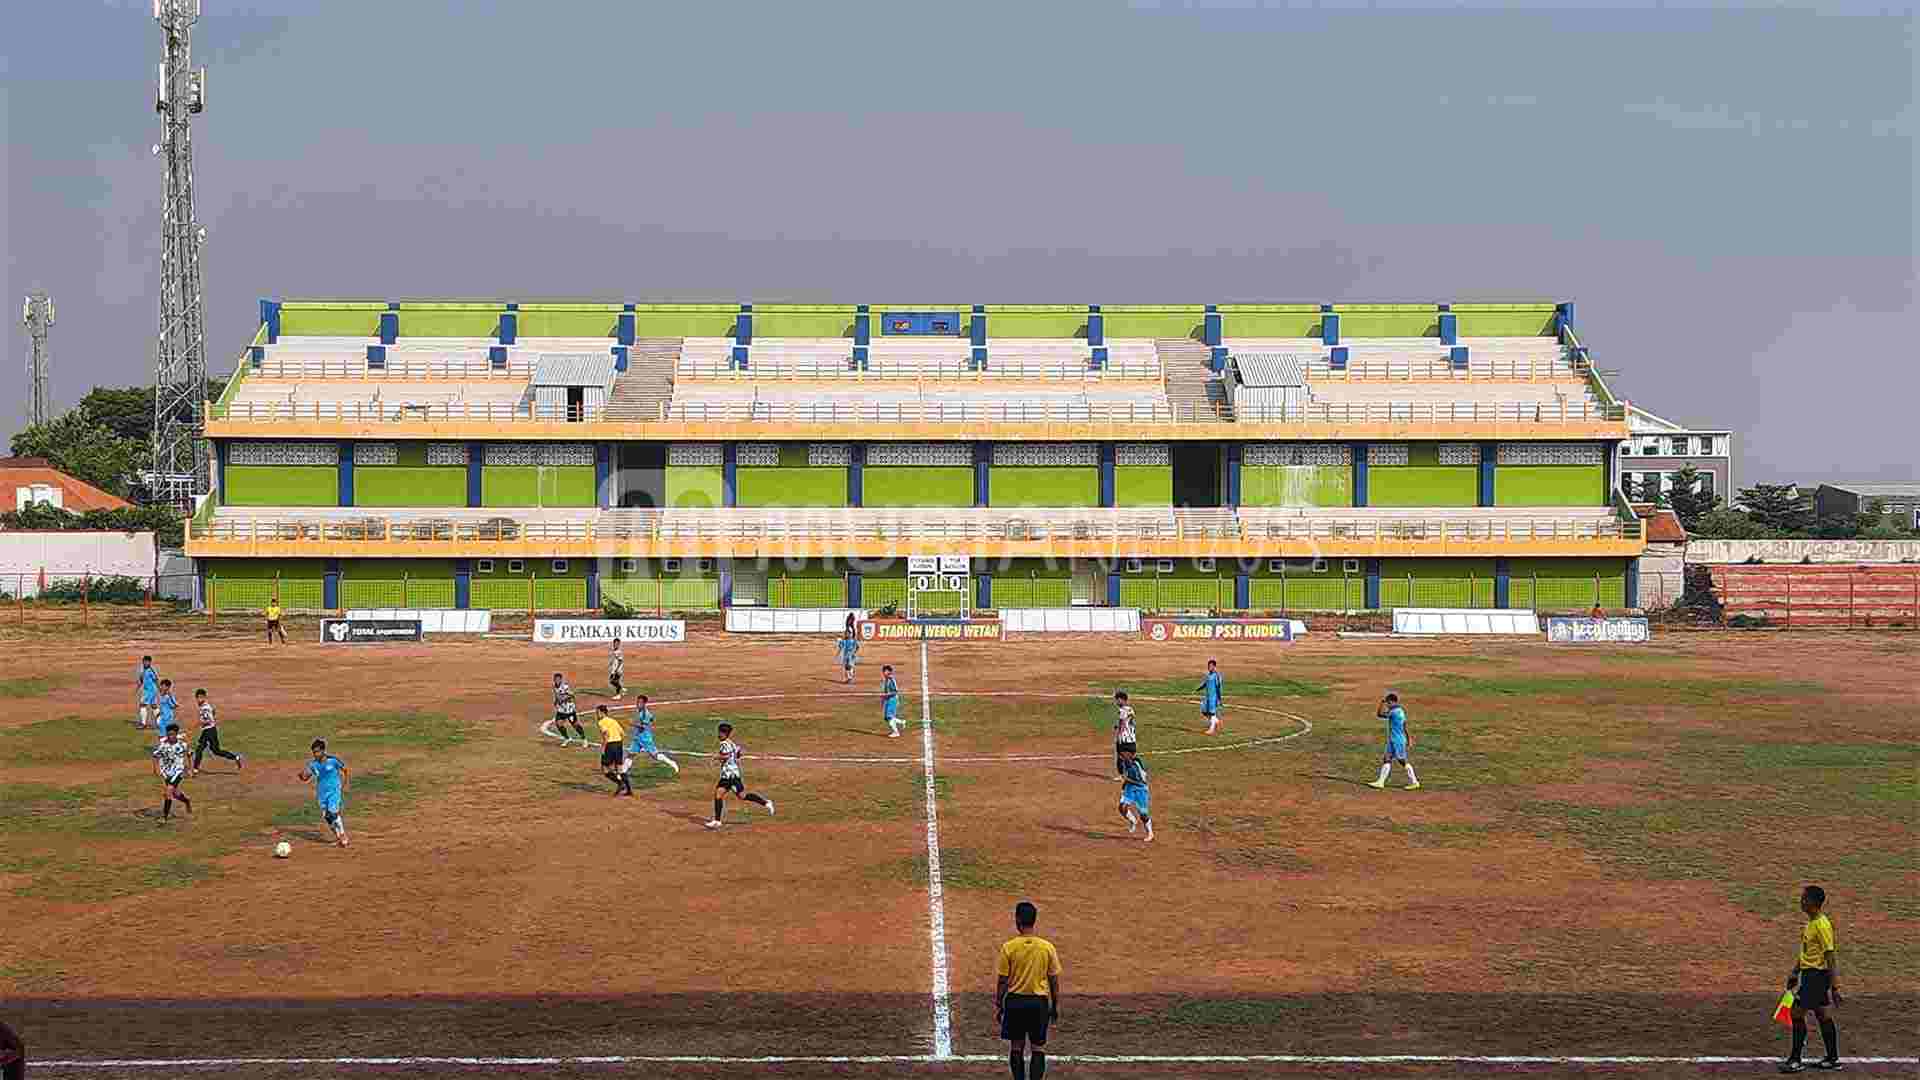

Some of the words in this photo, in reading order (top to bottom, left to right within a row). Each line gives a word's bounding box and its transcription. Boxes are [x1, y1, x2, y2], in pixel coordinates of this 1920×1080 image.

[561, 625, 622, 639] PEMKAB
[626, 625, 678, 639] KUDUS
[878, 624, 923, 638] STADION
[925, 624, 961, 638] WERGU
[963, 624, 1000, 638] WETAN
[1173, 624, 1213, 638] ASKAB
[1215, 624, 1242, 638] PSSI
[1244, 624, 1284, 638] KUDUS
